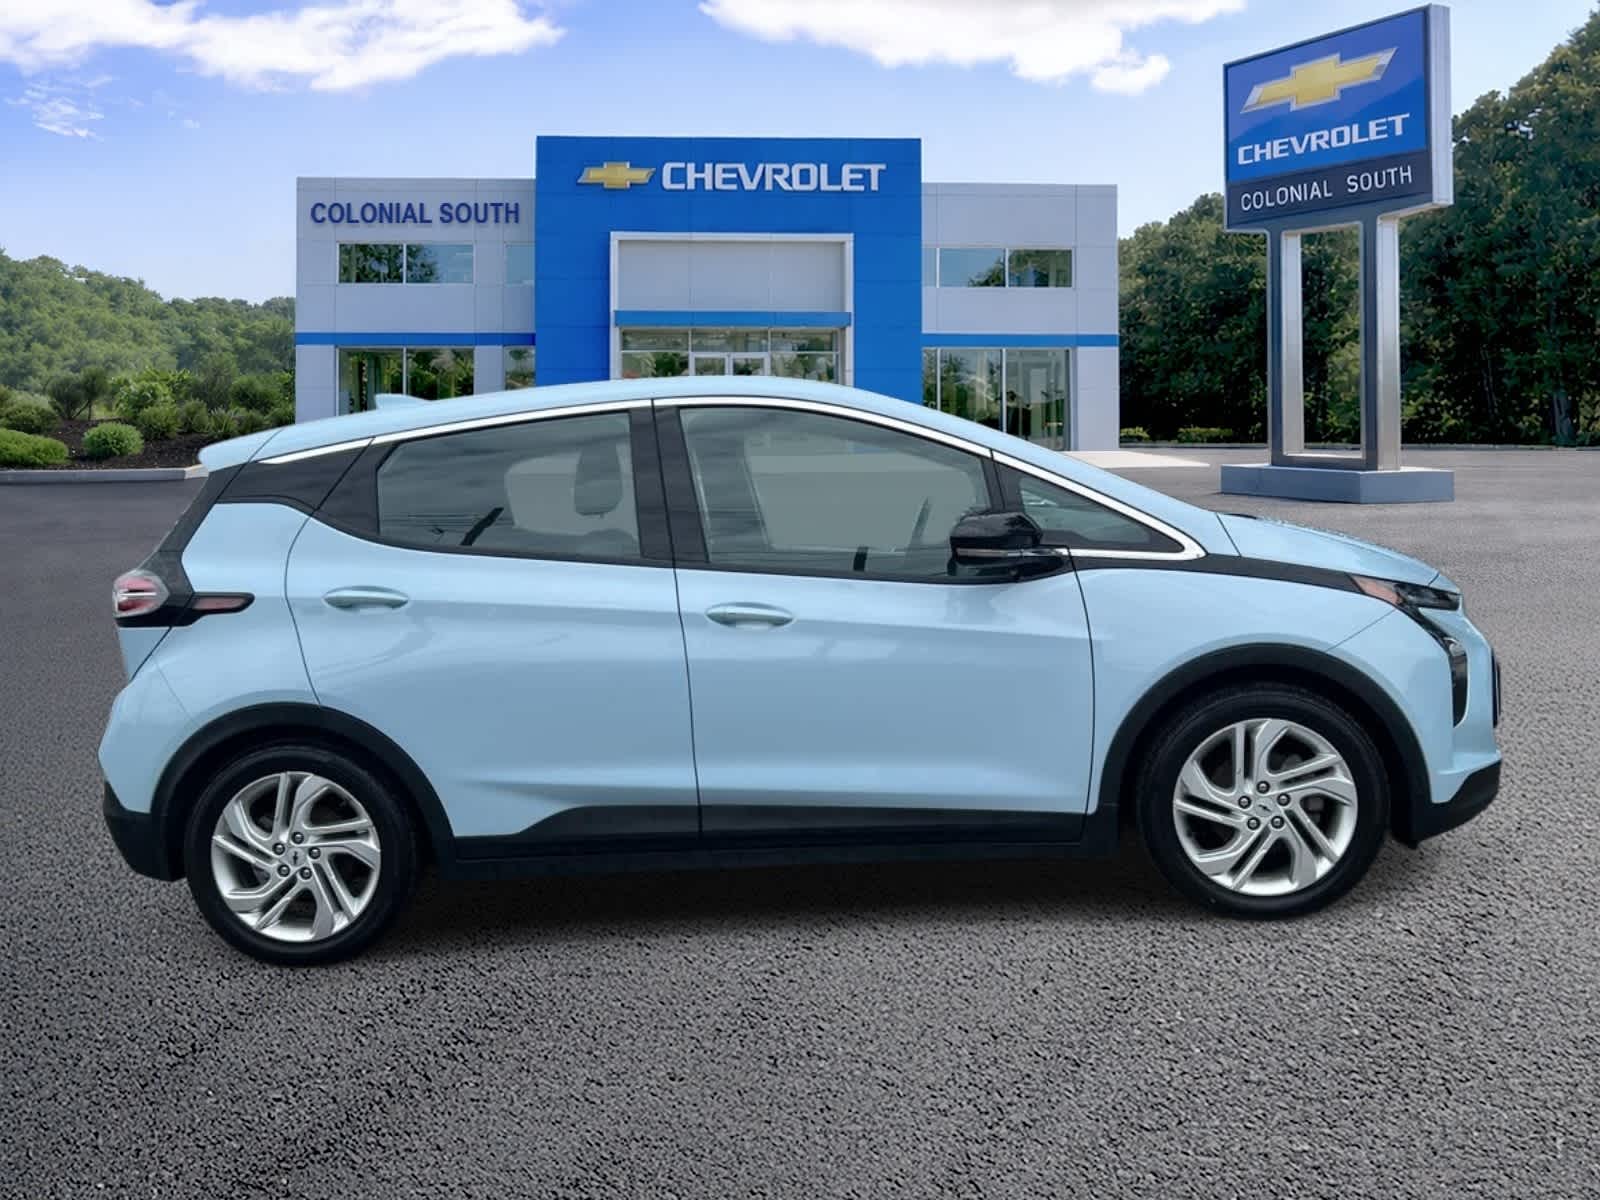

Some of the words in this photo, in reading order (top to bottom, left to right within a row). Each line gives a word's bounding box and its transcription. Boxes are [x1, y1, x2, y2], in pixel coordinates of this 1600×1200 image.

[1238, 113, 1410, 165] CHEVROLET
[661, 161, 887, 193] CHEVROLET
[1241, 180, 1333, 211] COLONIAL
[1346, 165, 1413, 193] SOUTH
[310, 201, 433, 225] COLONIAL
[439, 201, 521, 225] SOUTH
